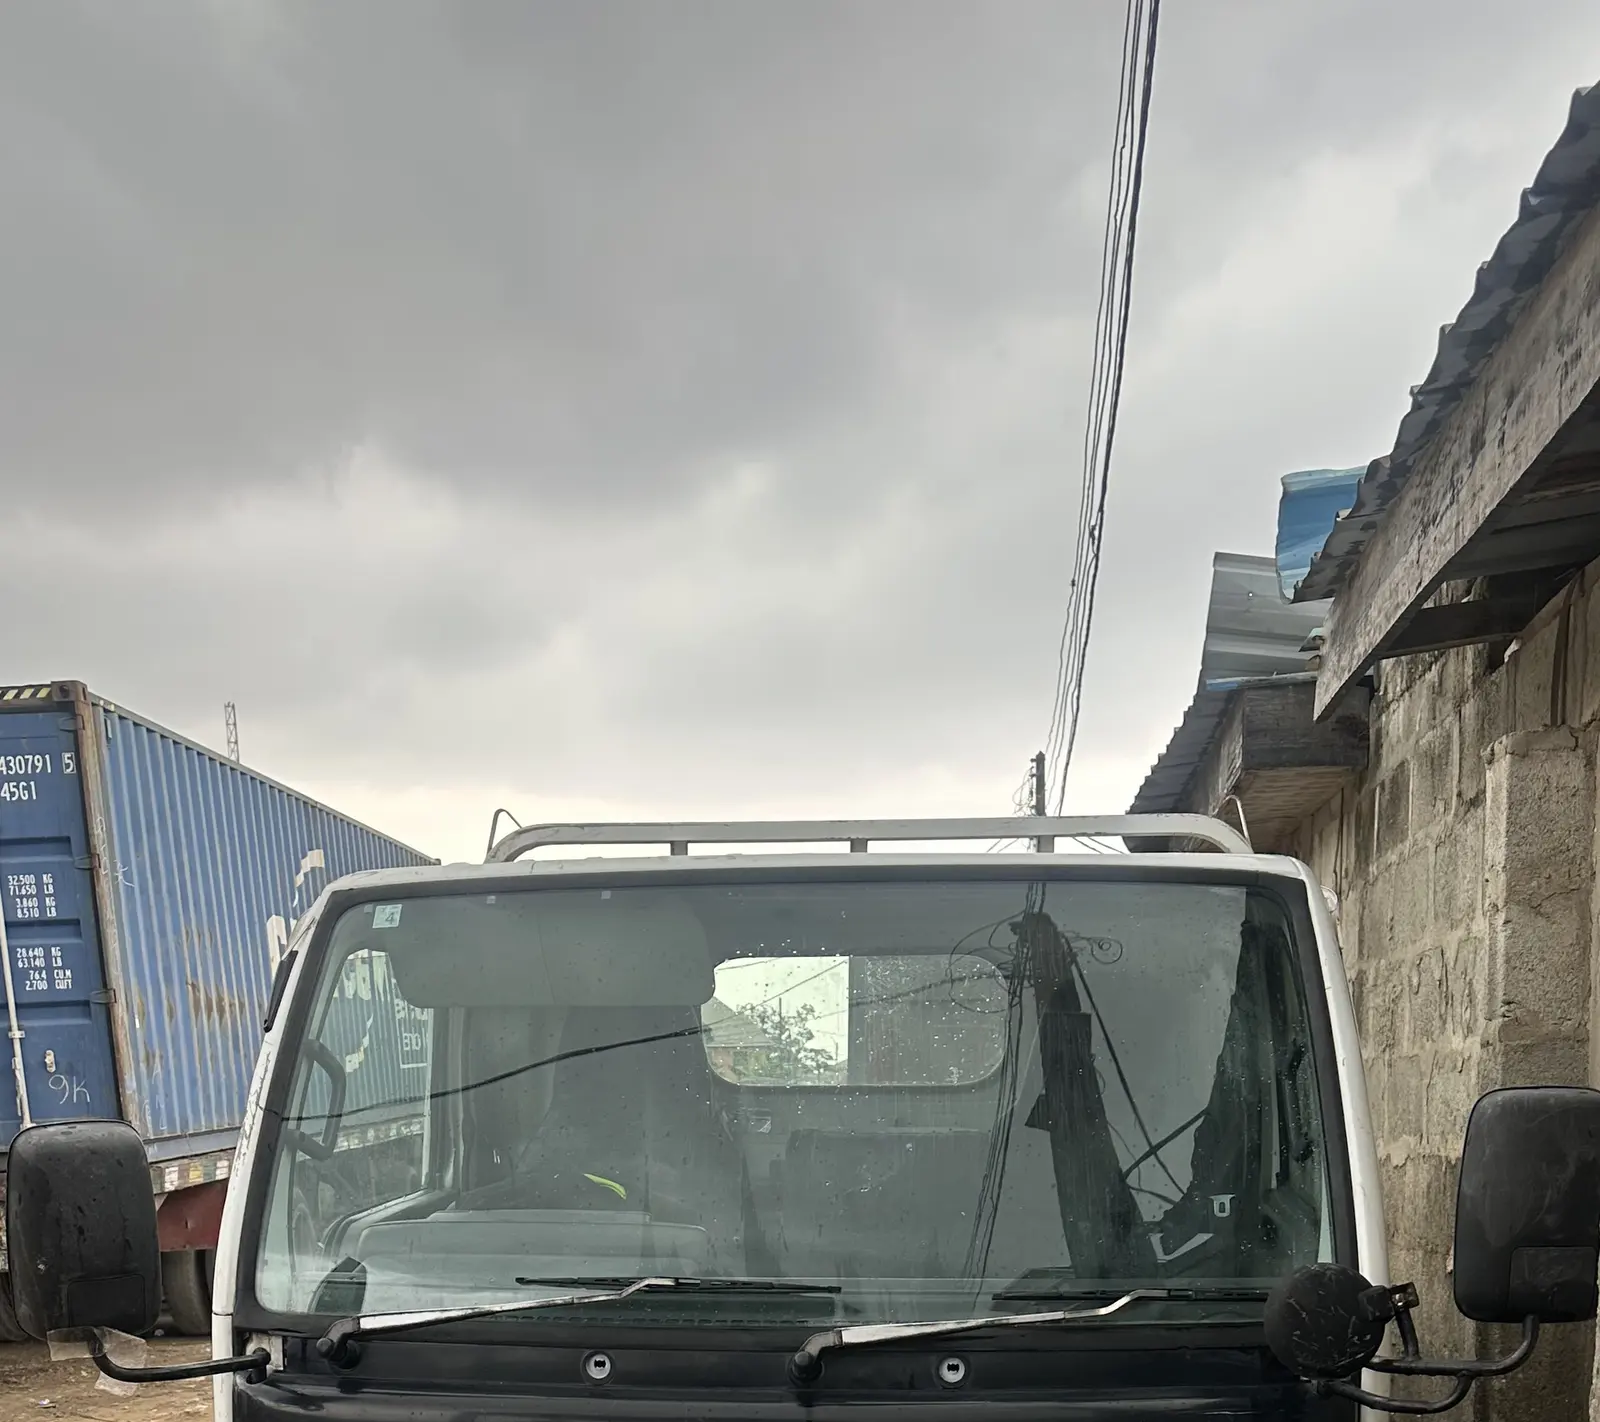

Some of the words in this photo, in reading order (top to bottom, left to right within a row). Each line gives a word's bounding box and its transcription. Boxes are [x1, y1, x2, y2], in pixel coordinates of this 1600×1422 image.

[0, 781, 36, 801] 45G1
[42, 873, 53, 884] KG
[43, 883, 55, 894] LB
[45, 896, 56, 907] KG
[46, 906, 57, 917] LB
[51, 946, 62, 957] KG
[52, 956, 63, 967] LB
